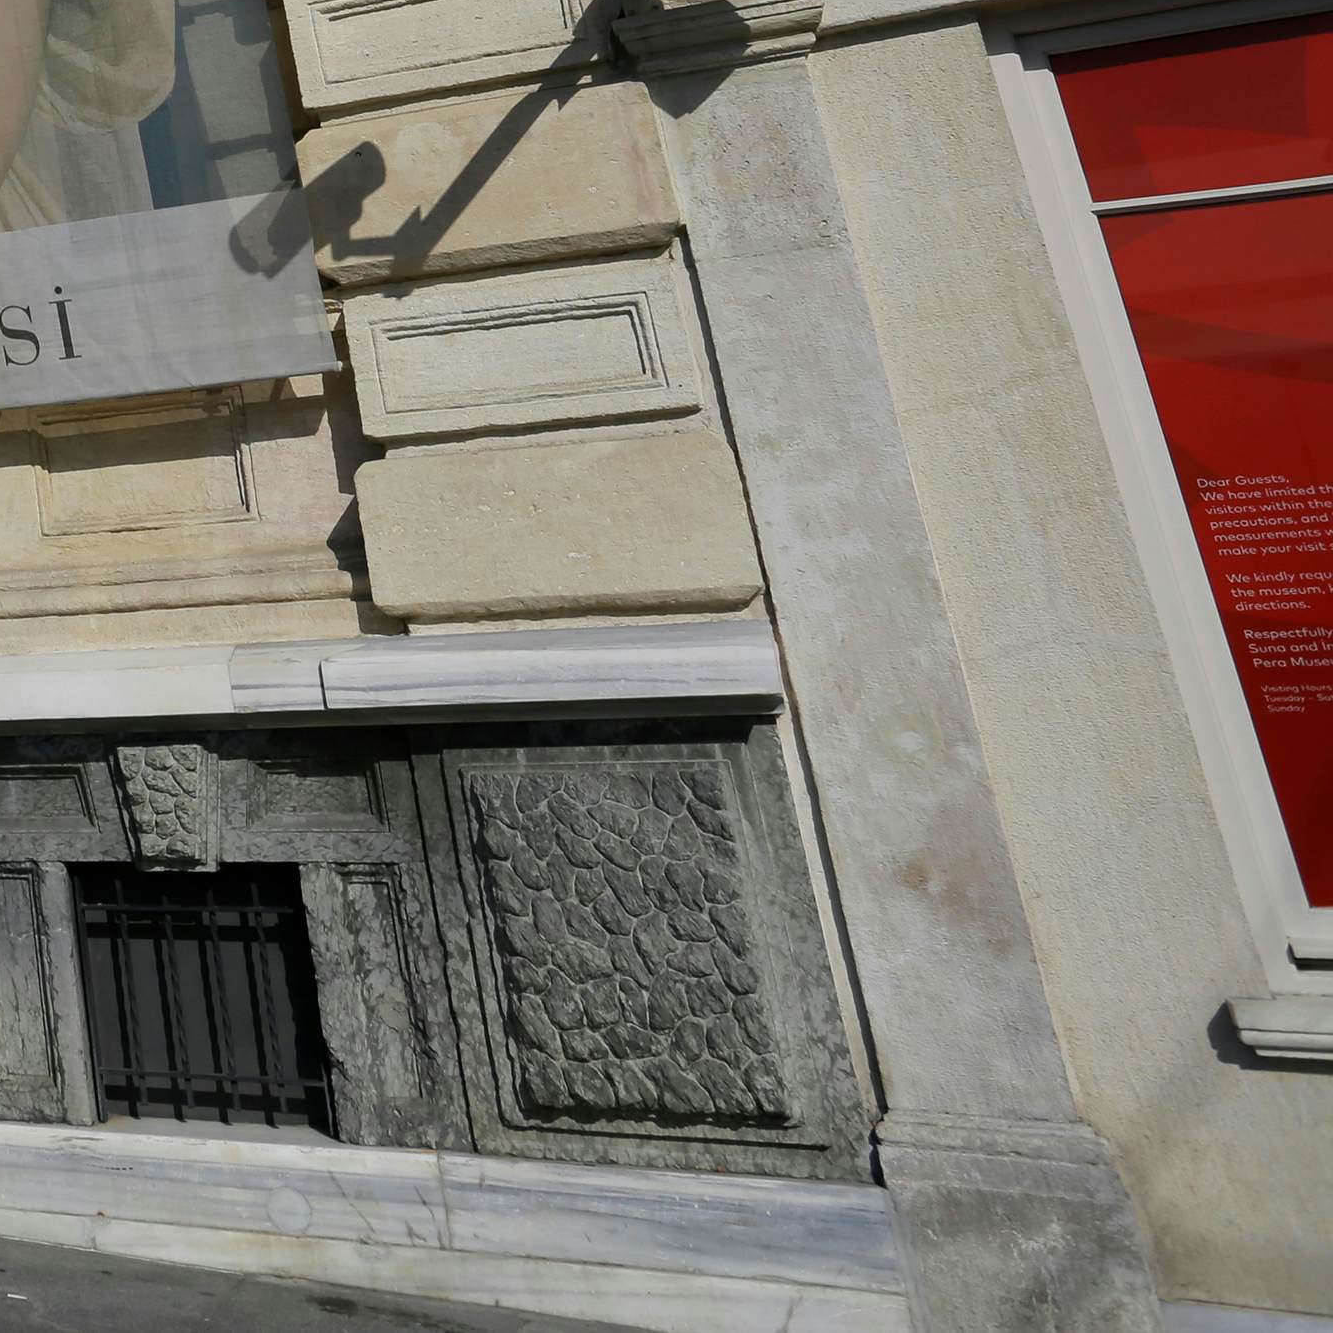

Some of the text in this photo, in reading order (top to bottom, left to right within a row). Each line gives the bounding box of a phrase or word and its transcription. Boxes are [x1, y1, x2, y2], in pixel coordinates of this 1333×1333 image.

[1196, 477, 1230, 488] Dear
[1200, 491, 1224, 502] We
[1228, 490, 1262, 500] have
[1264, 485, 1316, 497] limited
[1205, 504, 1256, 514] visitors
[1259, 501, 1305, 512] within
[1300, 513, 1329, 523] and
[1213, 528, 1322, 542] measurements
[1218, 542, 1327, 556] make your visit
[1225, 572, 1250, 583] We
[1253, 571, 1295, 583] kindly
[1230, 587, 1255, 598] the
[1248, 643, 1286, 654] Suna
[1290, 640, 1318, 652] and
[1252, 657, 1286, 668] Pera
[1267, 704, 1306, 713] Sunday
